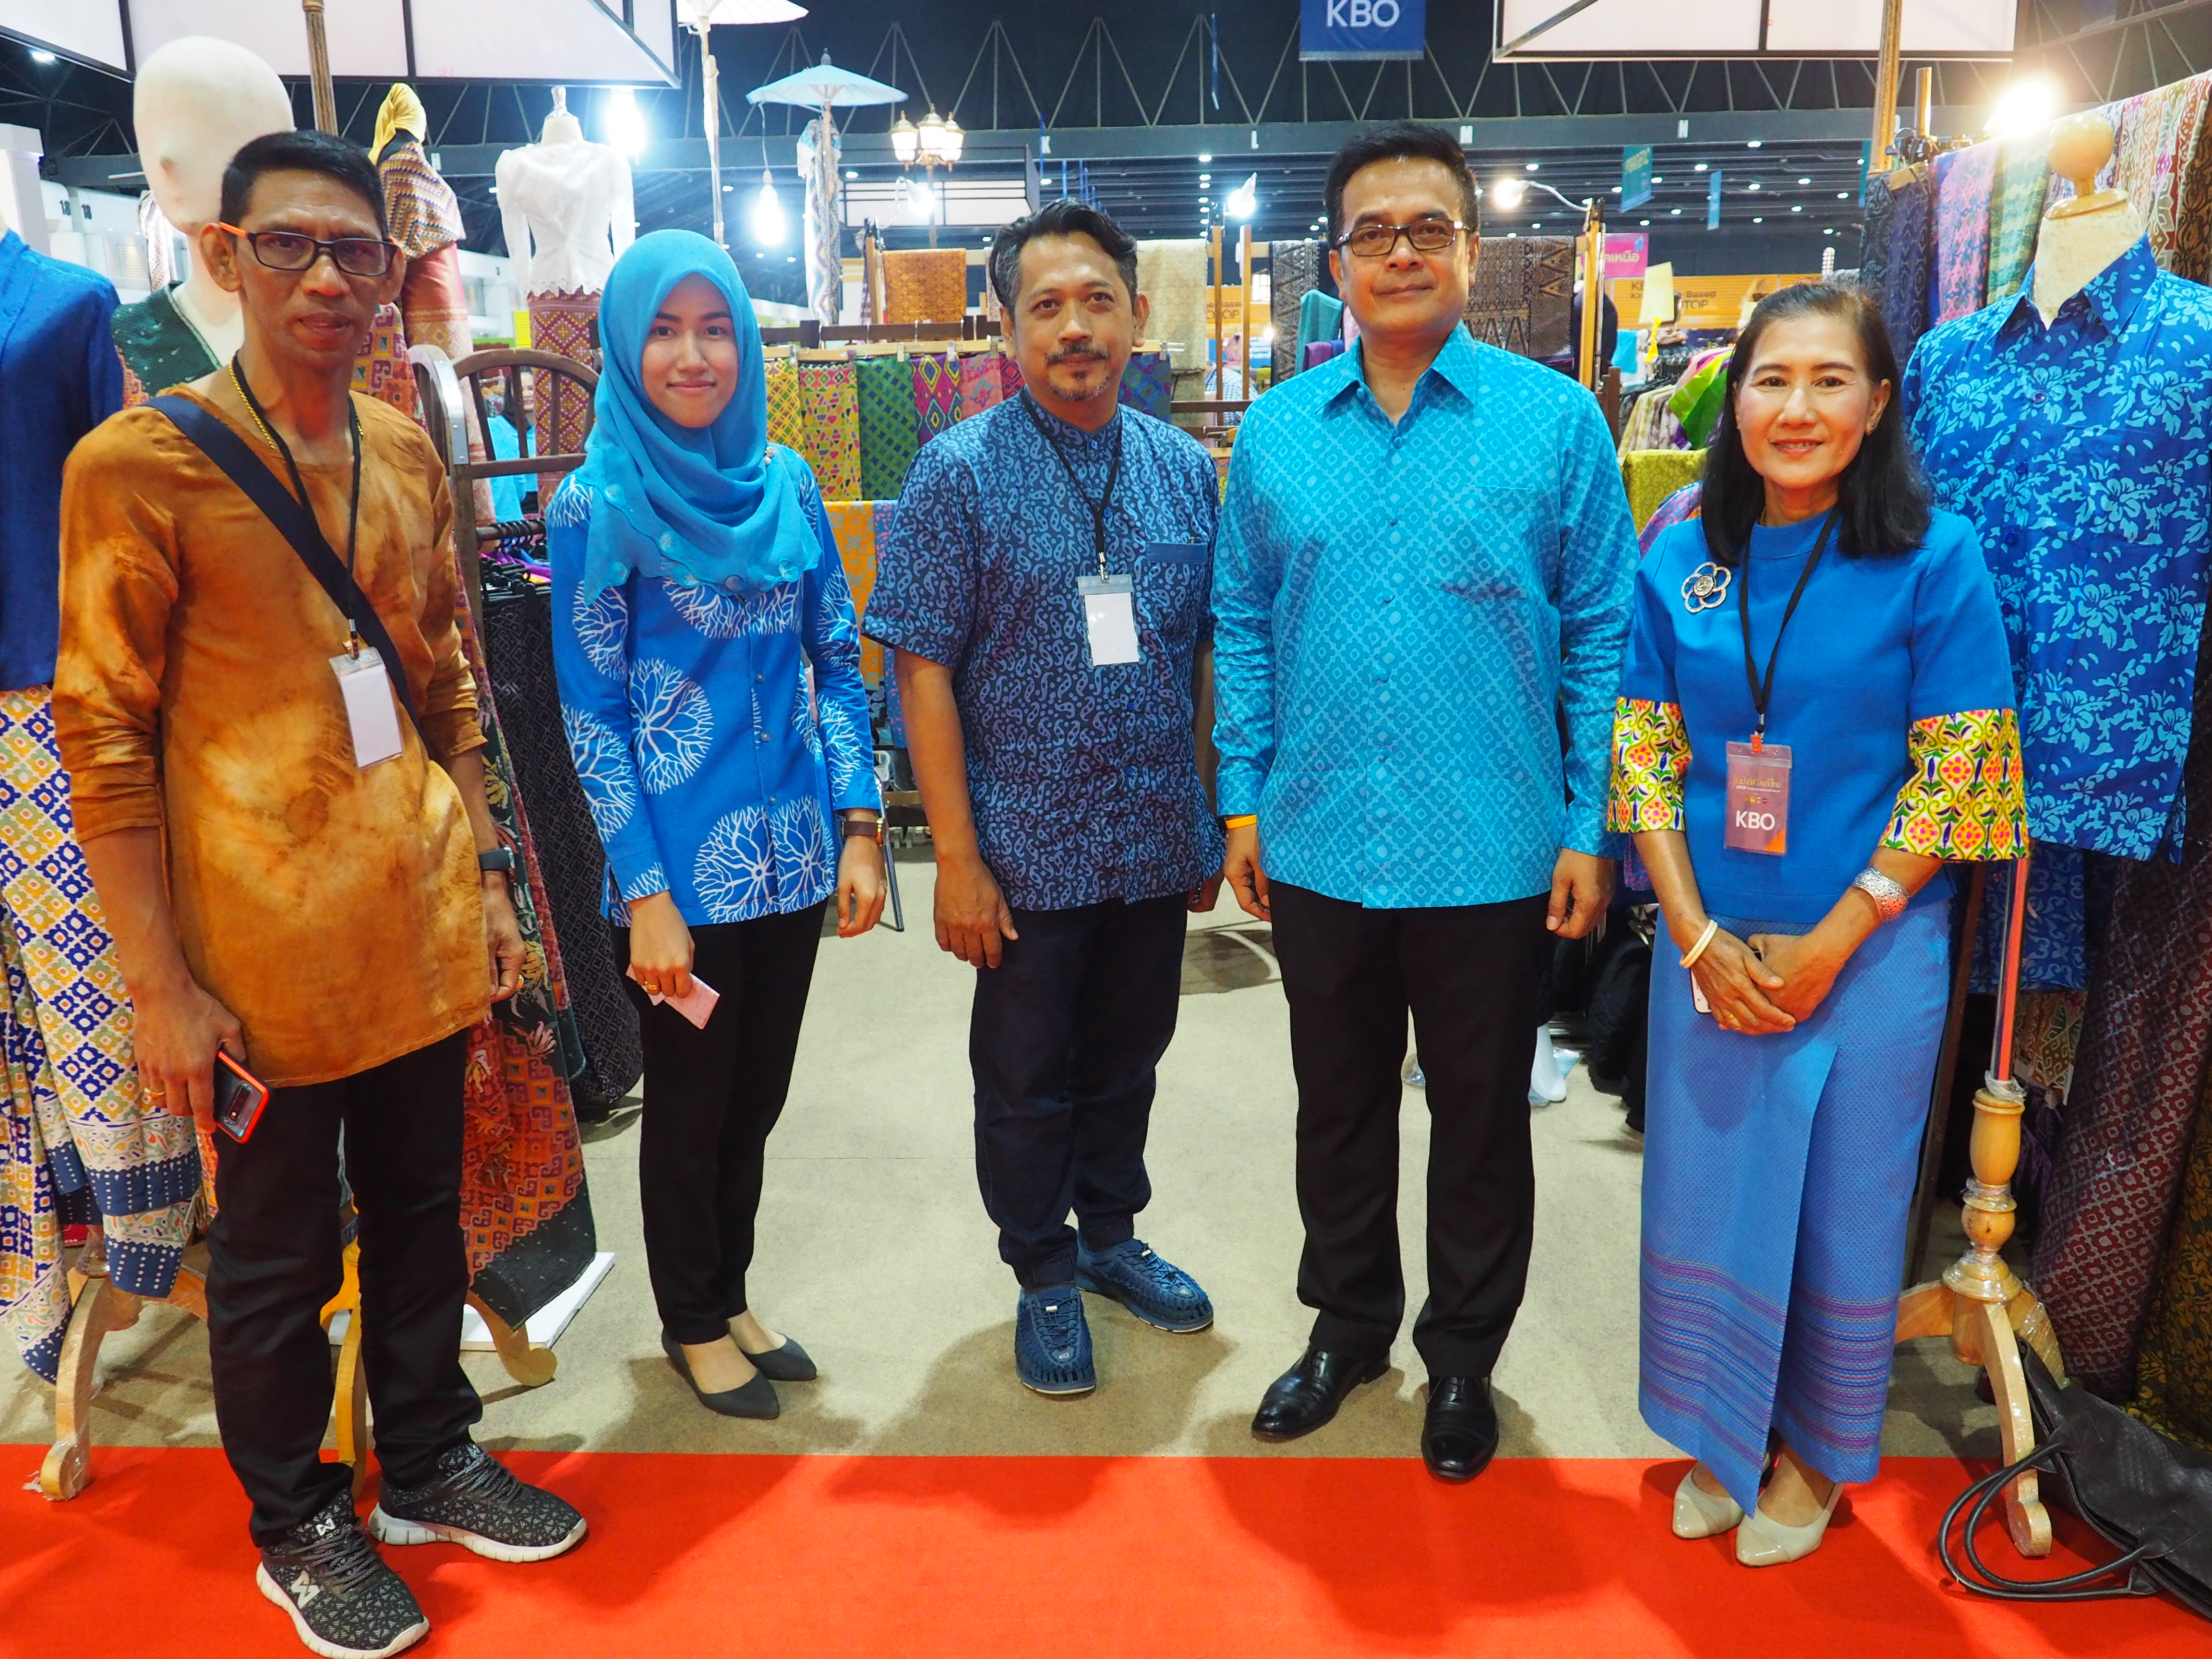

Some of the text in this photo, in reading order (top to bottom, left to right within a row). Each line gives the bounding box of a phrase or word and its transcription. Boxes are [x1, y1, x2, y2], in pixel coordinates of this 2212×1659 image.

[1326, 0, 1400, 27] KBO
[1460, 125, 1473, 144] M
[1678, 120, 1689, 139] N
[1042, 135, 1051, 154] K
[1251, 130, 1259, 149] L
[59, 199, 72, 216] 18
[1682, 299, 1709, 310] TOP
[1736, 810, 1776, 831] KBO
